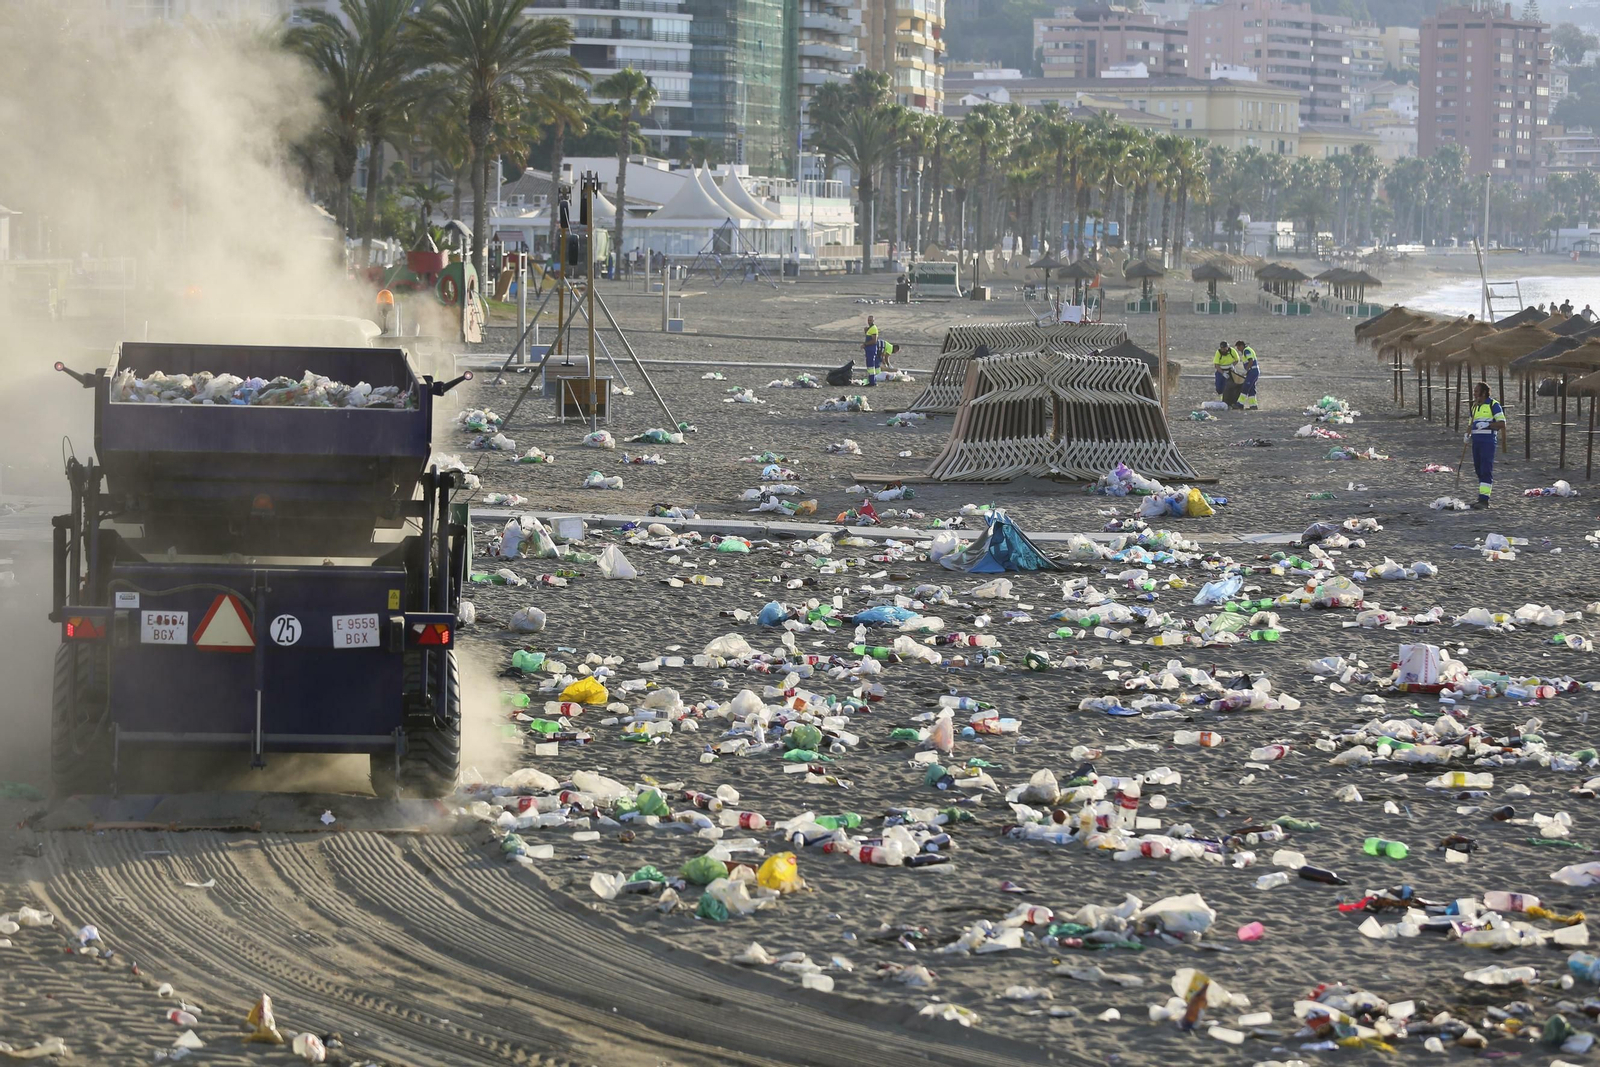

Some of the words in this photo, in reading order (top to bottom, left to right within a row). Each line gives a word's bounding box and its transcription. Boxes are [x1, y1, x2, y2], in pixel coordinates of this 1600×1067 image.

[147, 614, 154, 626] E
[336, 619, 343, 630] E
[347, 617, 376, 630] 9559
[153, 629, 175, 641] BGX
[277, 617, 296, 643] 25
[346, 632, 368, 645] BGX
